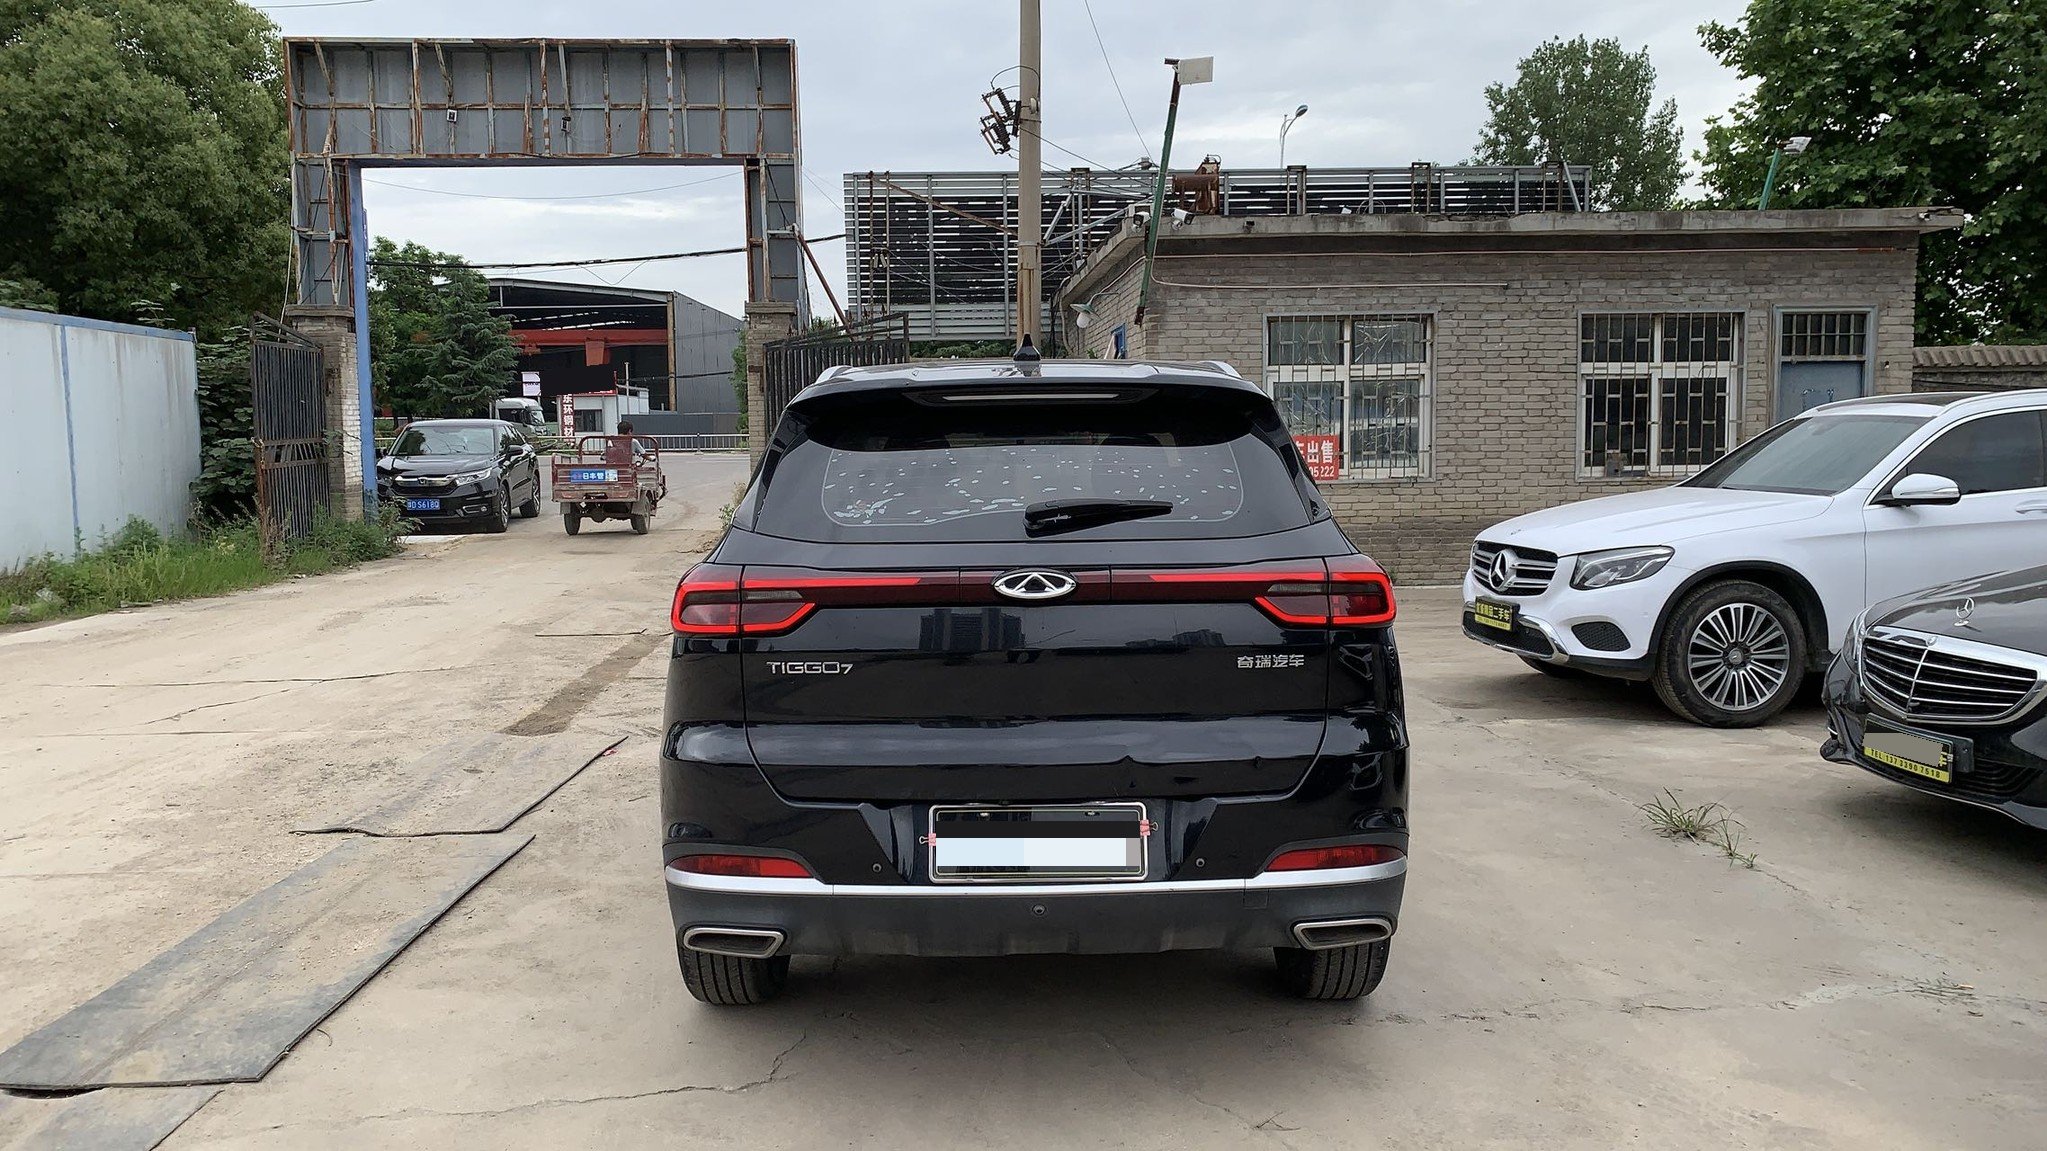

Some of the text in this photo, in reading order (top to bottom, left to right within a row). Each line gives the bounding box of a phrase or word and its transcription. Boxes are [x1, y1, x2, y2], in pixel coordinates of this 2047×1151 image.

[1237, 654, 1305, 669] 奇瑞汽车
[1871, 749, 1883, 760] TEL
